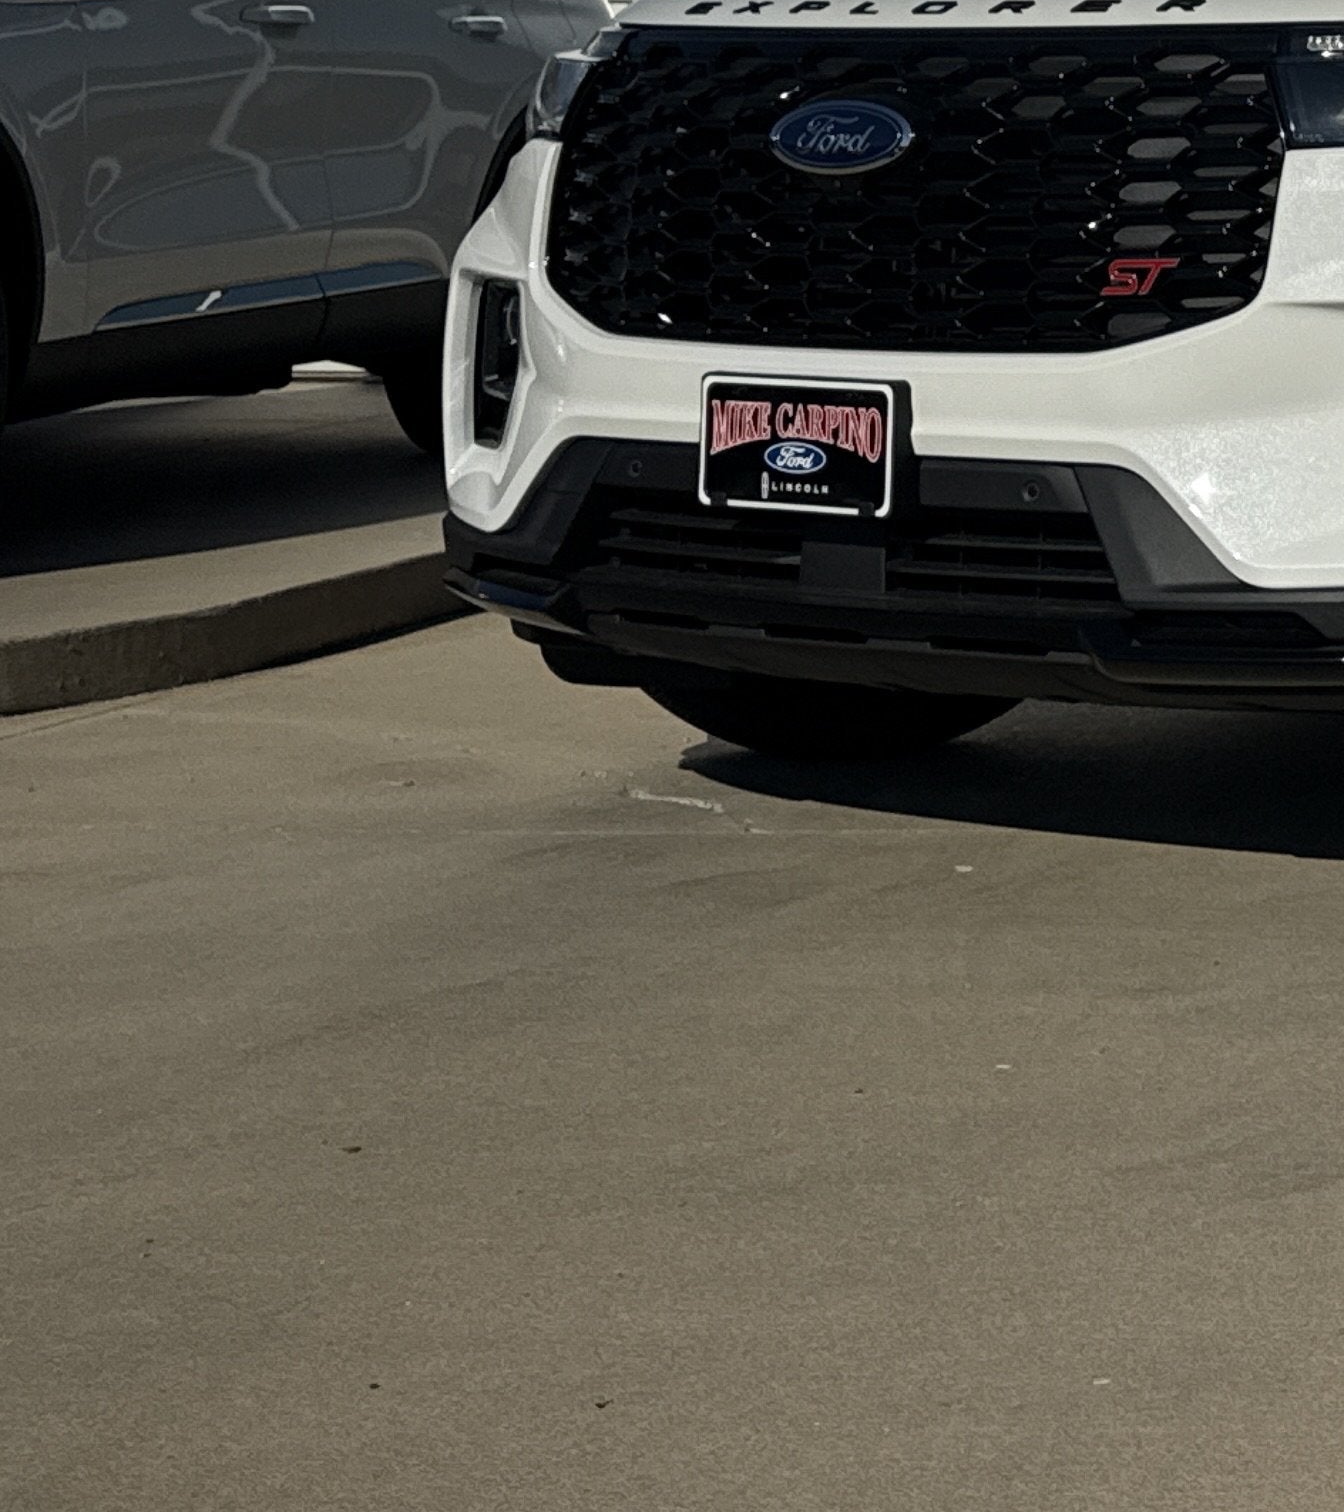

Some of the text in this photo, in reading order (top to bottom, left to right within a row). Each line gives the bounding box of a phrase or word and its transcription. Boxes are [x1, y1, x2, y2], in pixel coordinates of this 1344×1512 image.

[797, 114, 875, 155] Ford
[1100, 257, 1180, 295] ST
[710, 399, 883, 463] MIKE CARPINO
[776, 445, 814, 469] Ford
[771, 481, 829, 494] LINCOLN
